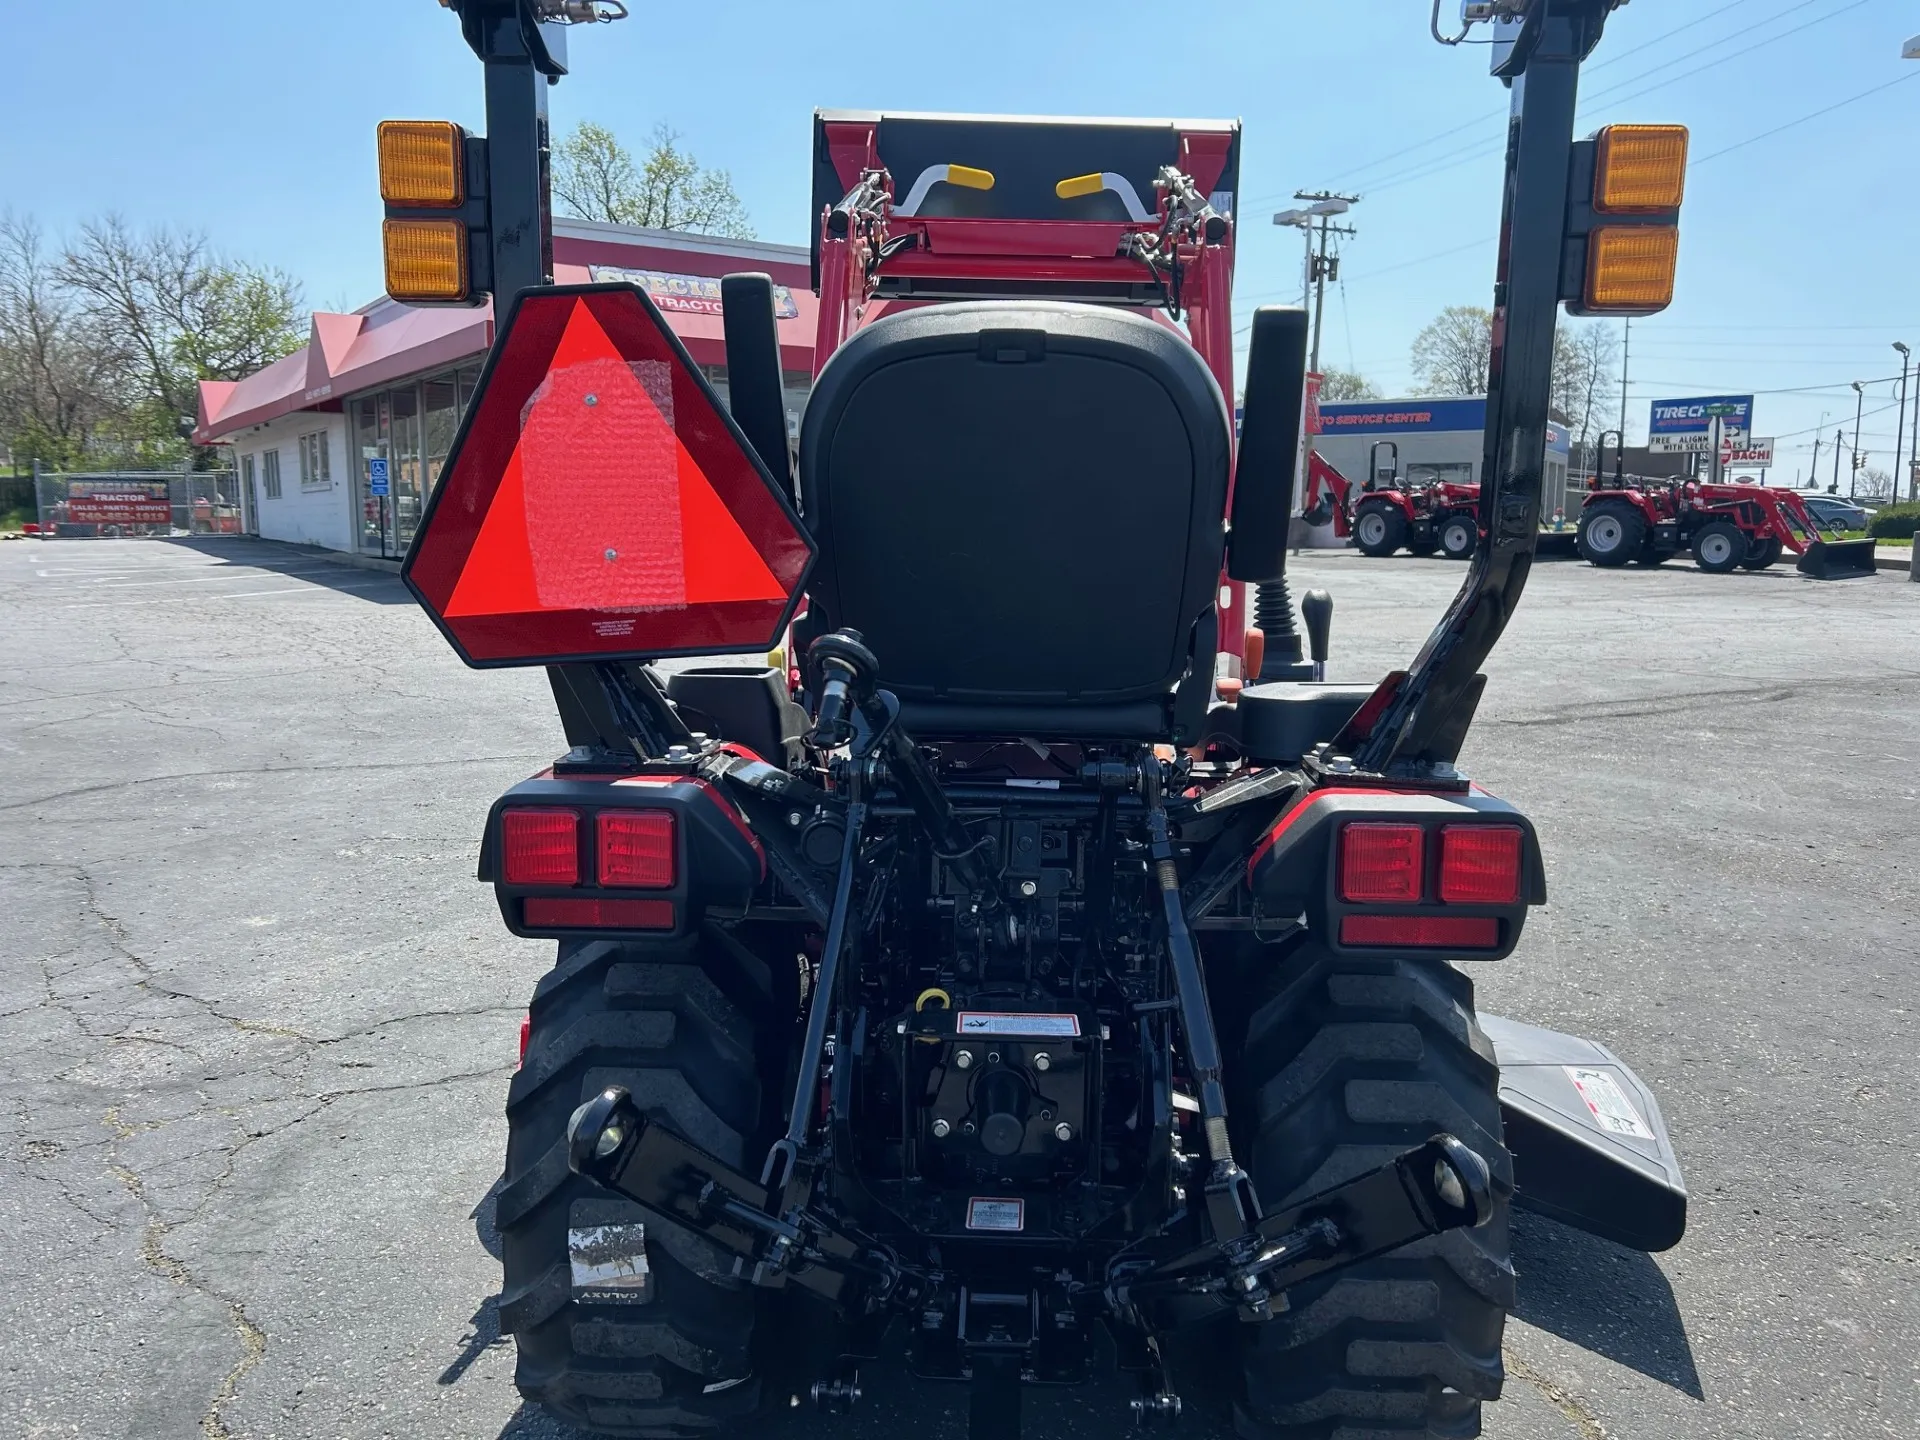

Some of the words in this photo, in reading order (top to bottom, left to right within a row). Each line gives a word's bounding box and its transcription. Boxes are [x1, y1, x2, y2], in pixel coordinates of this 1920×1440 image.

[655, 296, 722, 311] TRACTO
[1336, 413, 1384, 425] SERVICE
[1385, 412, 1432, 423] CENTER
[1663, 443, 1683, 451] WITH
[92, 494, 146, 502] TRACTOR
